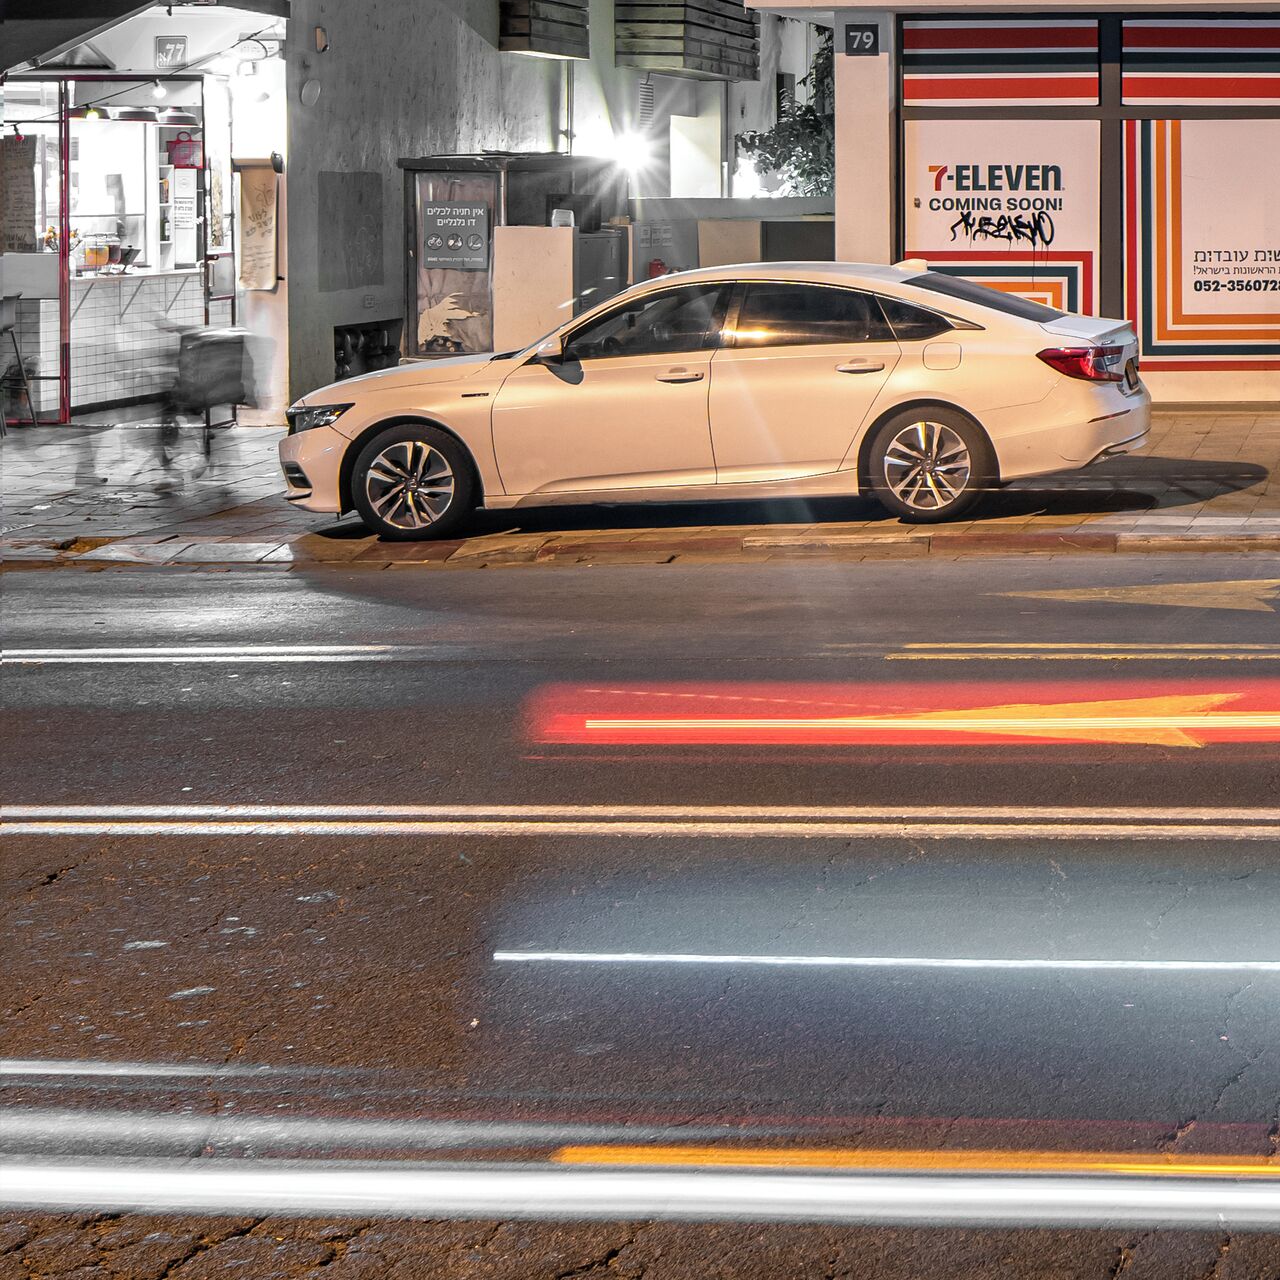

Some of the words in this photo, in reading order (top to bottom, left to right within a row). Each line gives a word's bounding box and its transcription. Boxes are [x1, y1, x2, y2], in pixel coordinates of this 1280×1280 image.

[849, 31, 874, 49] 79
[929, 197, 1002, 211] COMING
[1006, 197, 1063, 211] SOON!
[426, 207, 451, 216] לכלים
[452, 207, 471, 216] חניה
[472, 207, 484, 217] אין
[467, 218, 476, 226] דו
[1193, 265, 1230, 275] בישראל!
[1233, 265, 1276, 275] הראשונות
